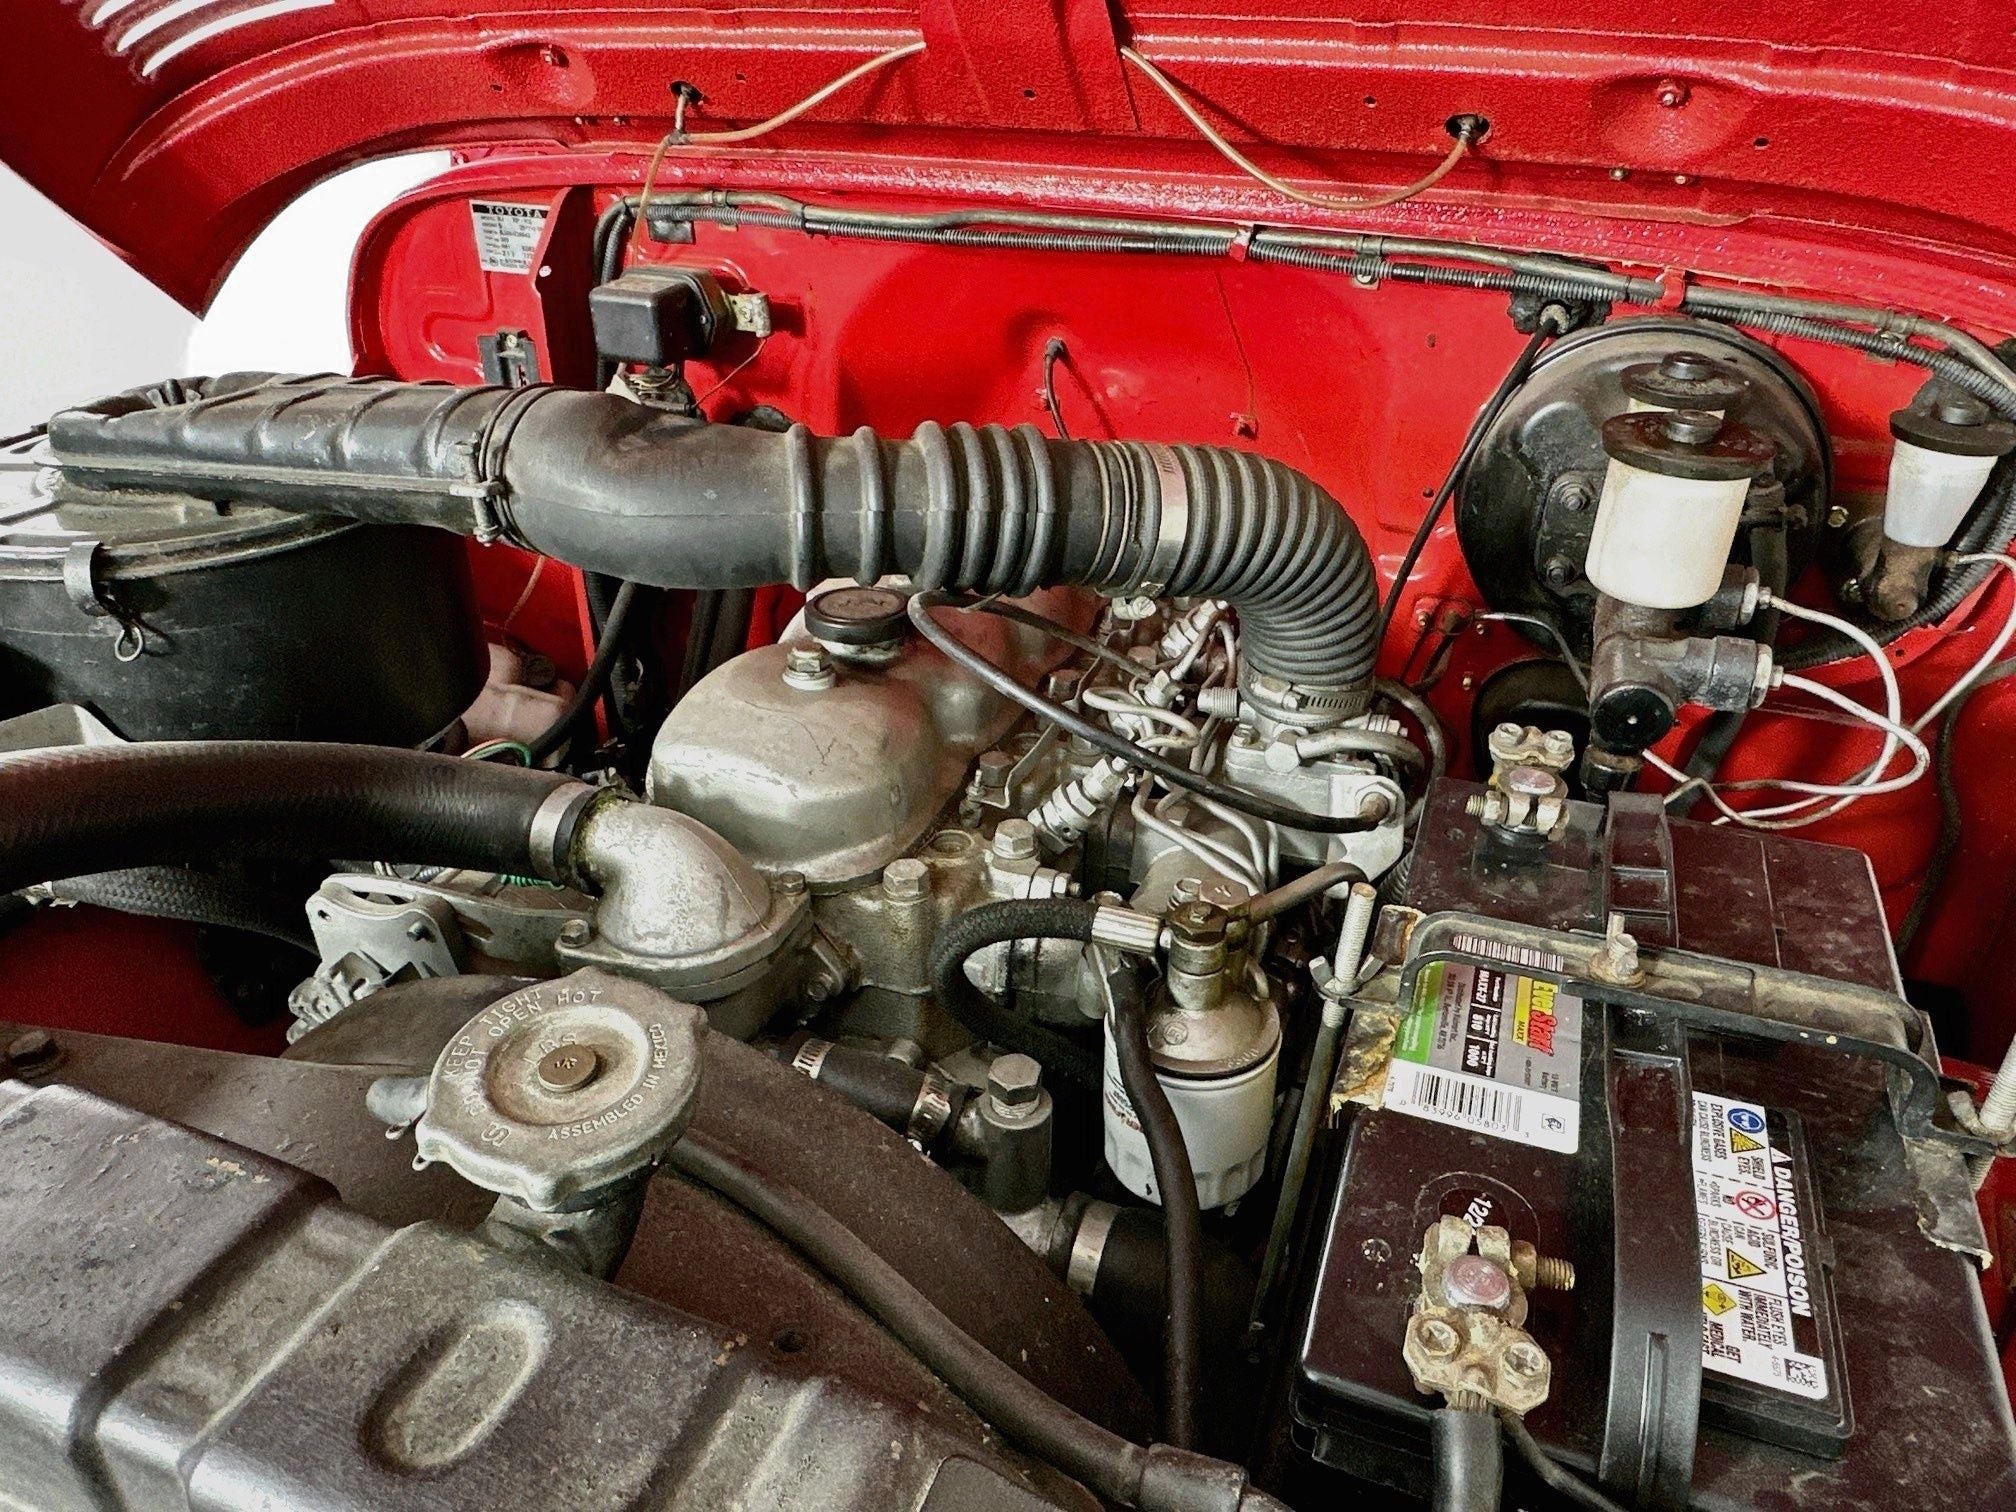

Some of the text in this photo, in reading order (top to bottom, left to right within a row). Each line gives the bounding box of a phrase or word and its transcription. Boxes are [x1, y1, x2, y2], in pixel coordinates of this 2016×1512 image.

[486, 205, 543, 219] TOYOTA
[441, 987, 543, 1080] KEEP TIGHT
[489, 1002, 542, 1037] OPEN
[557, 988, 602, 1005] HOT
[1529, 980, 1559, 1056] EverStart
[548, 1023, 669, 1141] ASSEMBLED IN MEXICO
[1711, 1103, 1725, 1137] EXPLOSIVE
[1463, 1197, 1493, 1235] 12/2
[1762, 1232, 1778, 1270] SULFURIC
[1774, 1166, 1811, 1317] DANGER/POISON
[1709, 1321, 1726, 1358] MEDICAL
[1738, 1290, 1756, 1342] WITH WATER.
[1754, 1293, 1773, 1349] IMMEDIATELY
[1769, 1299, 1787, 1346] FLUSH EYES
[1726, 1345, 1741, 1363] GET
